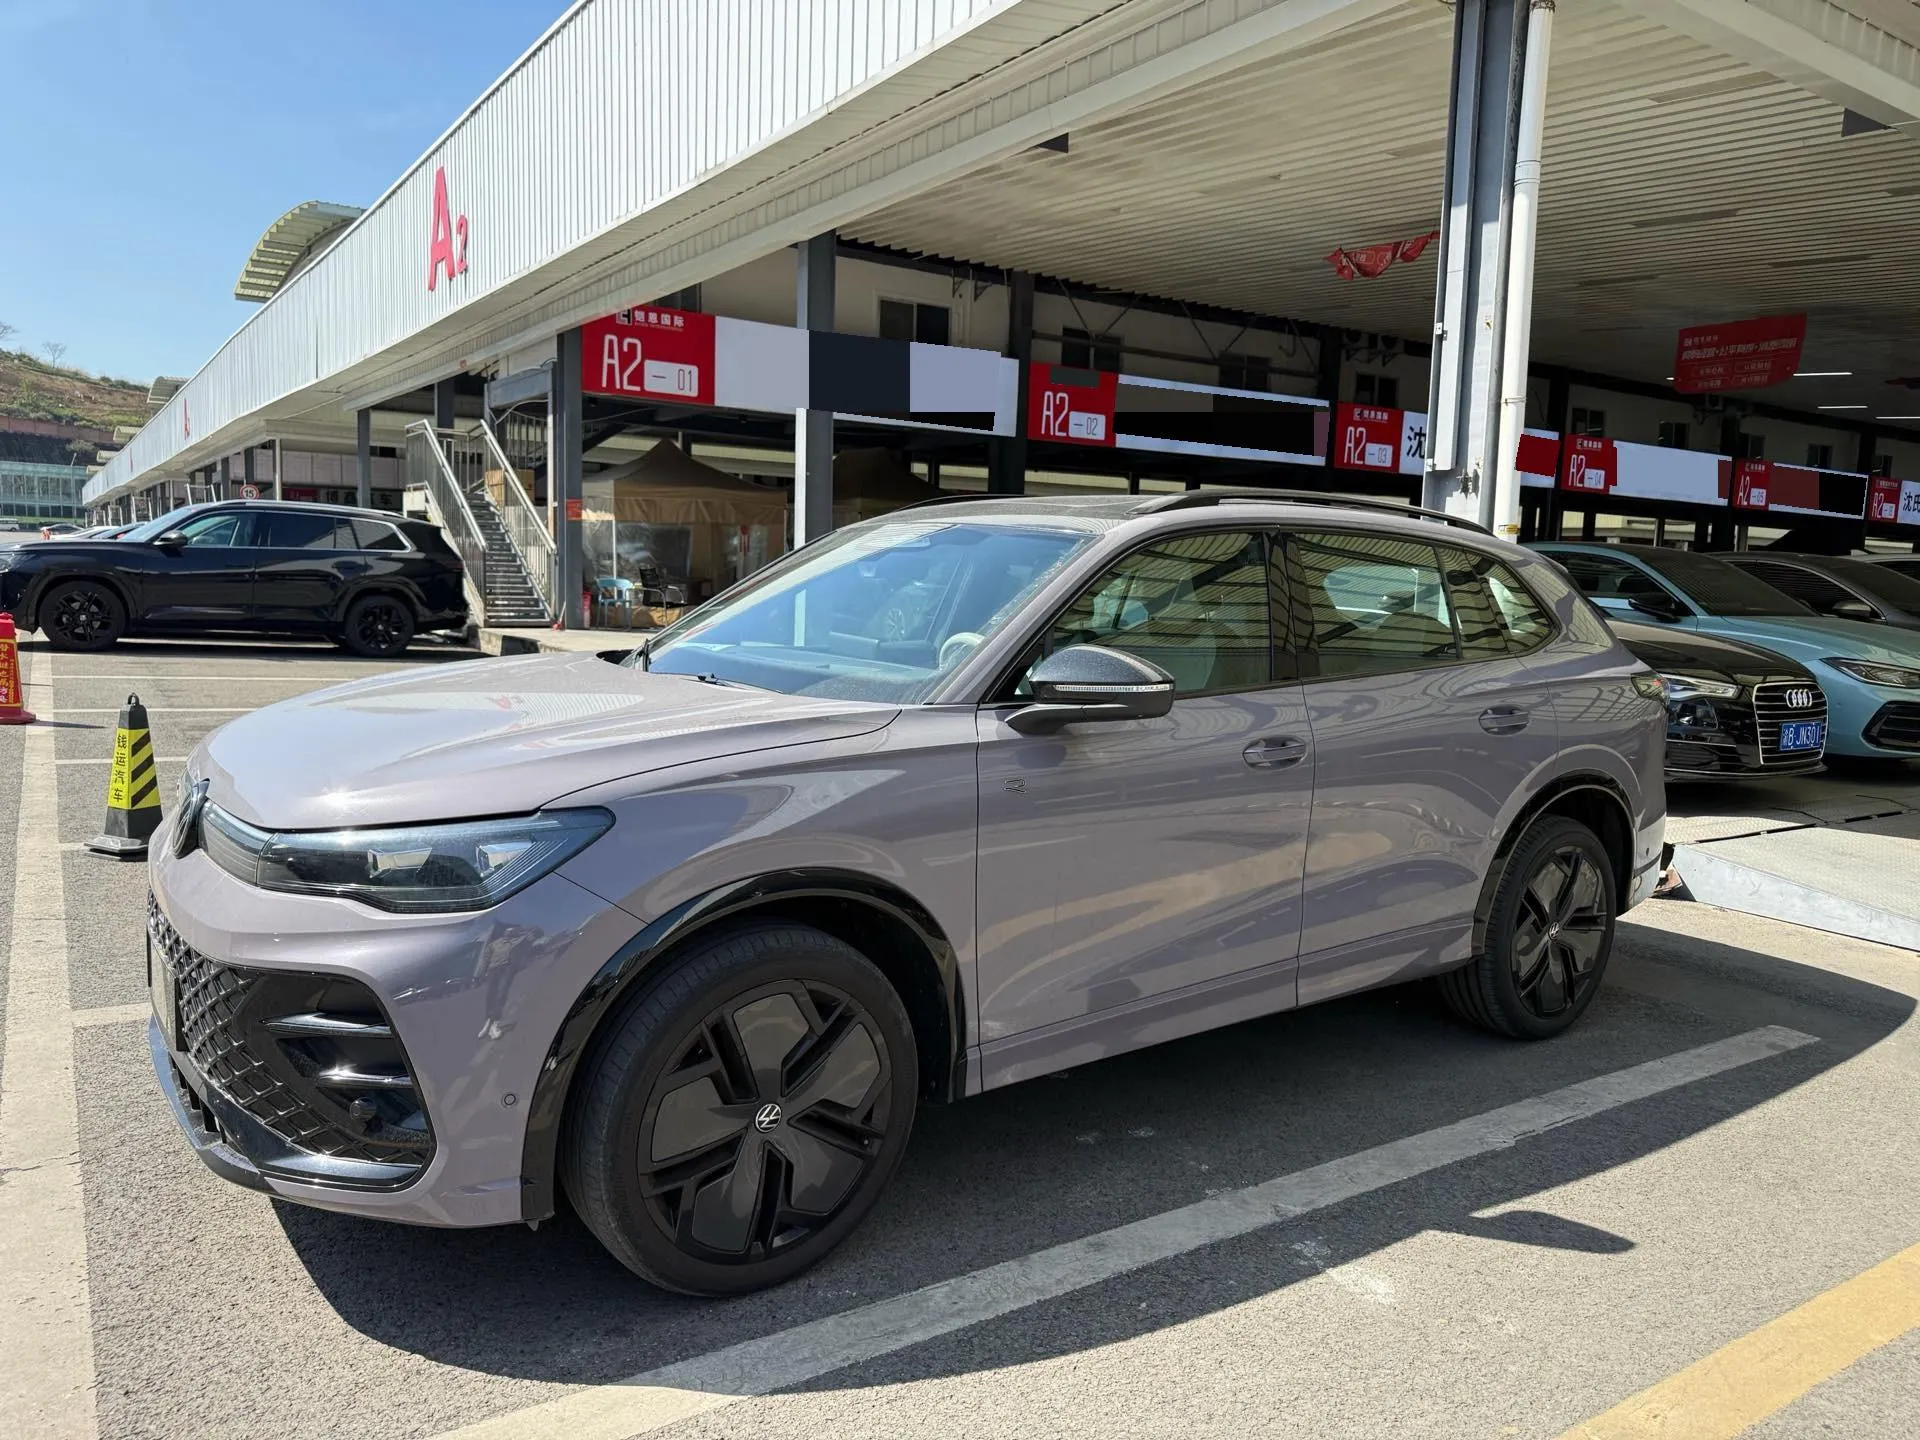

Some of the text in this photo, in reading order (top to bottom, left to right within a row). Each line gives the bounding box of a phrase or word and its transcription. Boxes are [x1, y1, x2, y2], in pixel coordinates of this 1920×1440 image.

[428, 167, 468, 291] A2
[602, 334, 642, 391] A2
[1041, 391, 1069, 437] A2
[1344, 426, 1366, 465] A2
